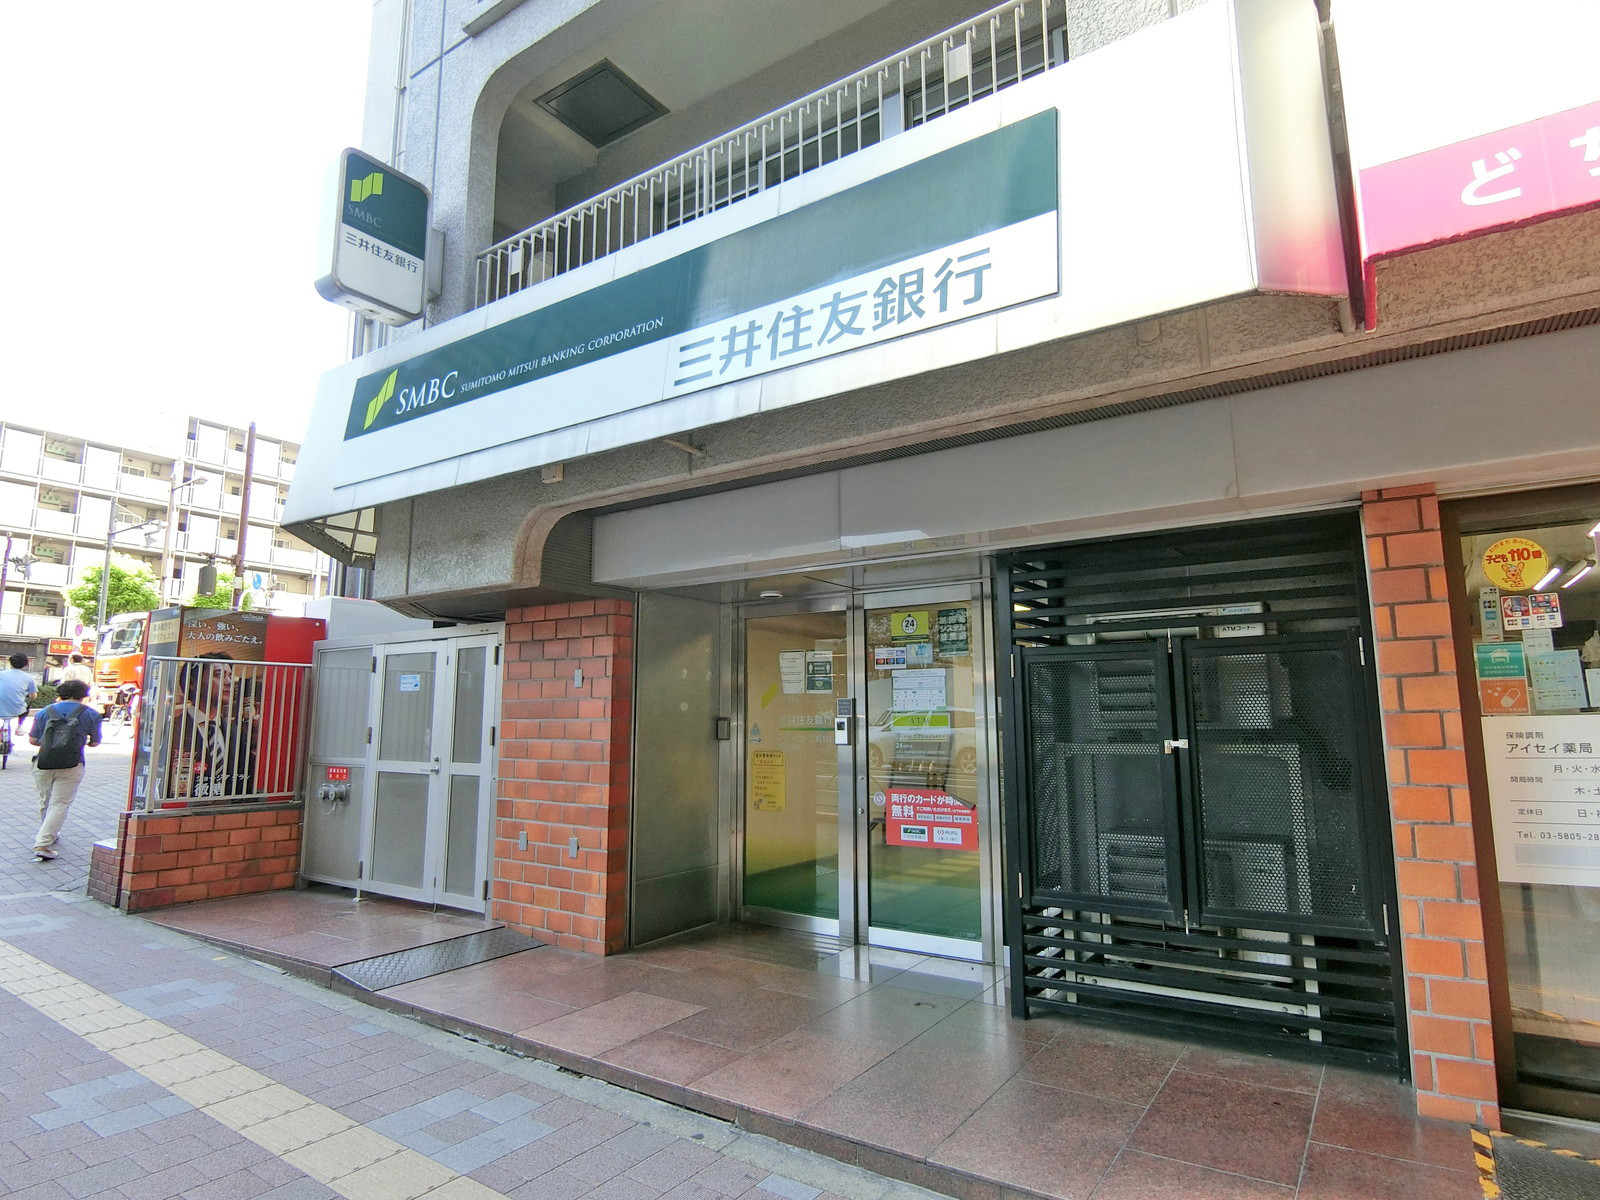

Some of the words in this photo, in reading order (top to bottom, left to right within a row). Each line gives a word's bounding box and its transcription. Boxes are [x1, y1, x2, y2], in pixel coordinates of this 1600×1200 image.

[348, 204, 383, 229] SMBC
[345, 231, 418, 274] 三井住友銀行
[673, 246, 992, 387] 三井住友銀行
[396, 371, 458, 415] SMBC
[460, 370, 507, 394] SUMITOMO
[508, 359, 539, 383] MITSUI
[541, 344, 585, 367] BANKING
[588, 317, 664, 351] CORPORATION
[188, 620, 239, 632] 深い、強い、
[904, 619, 915, 628] 24
[188, 631, 263, 645] 大人の飲みごたえ。
[1506, 731, 1544, 739] 保険調剤
[1506, 742, 1593, 754] アイセイ薬局
[1553, 764, 1600, 774] 月・火・水
[1510, 776, 1543, 784] 開局時間
[891, 805, 915, 818] 無料
[1517, 808, 1543, 816] 定休日
[1517, 831, 1536, 839] Tel.
